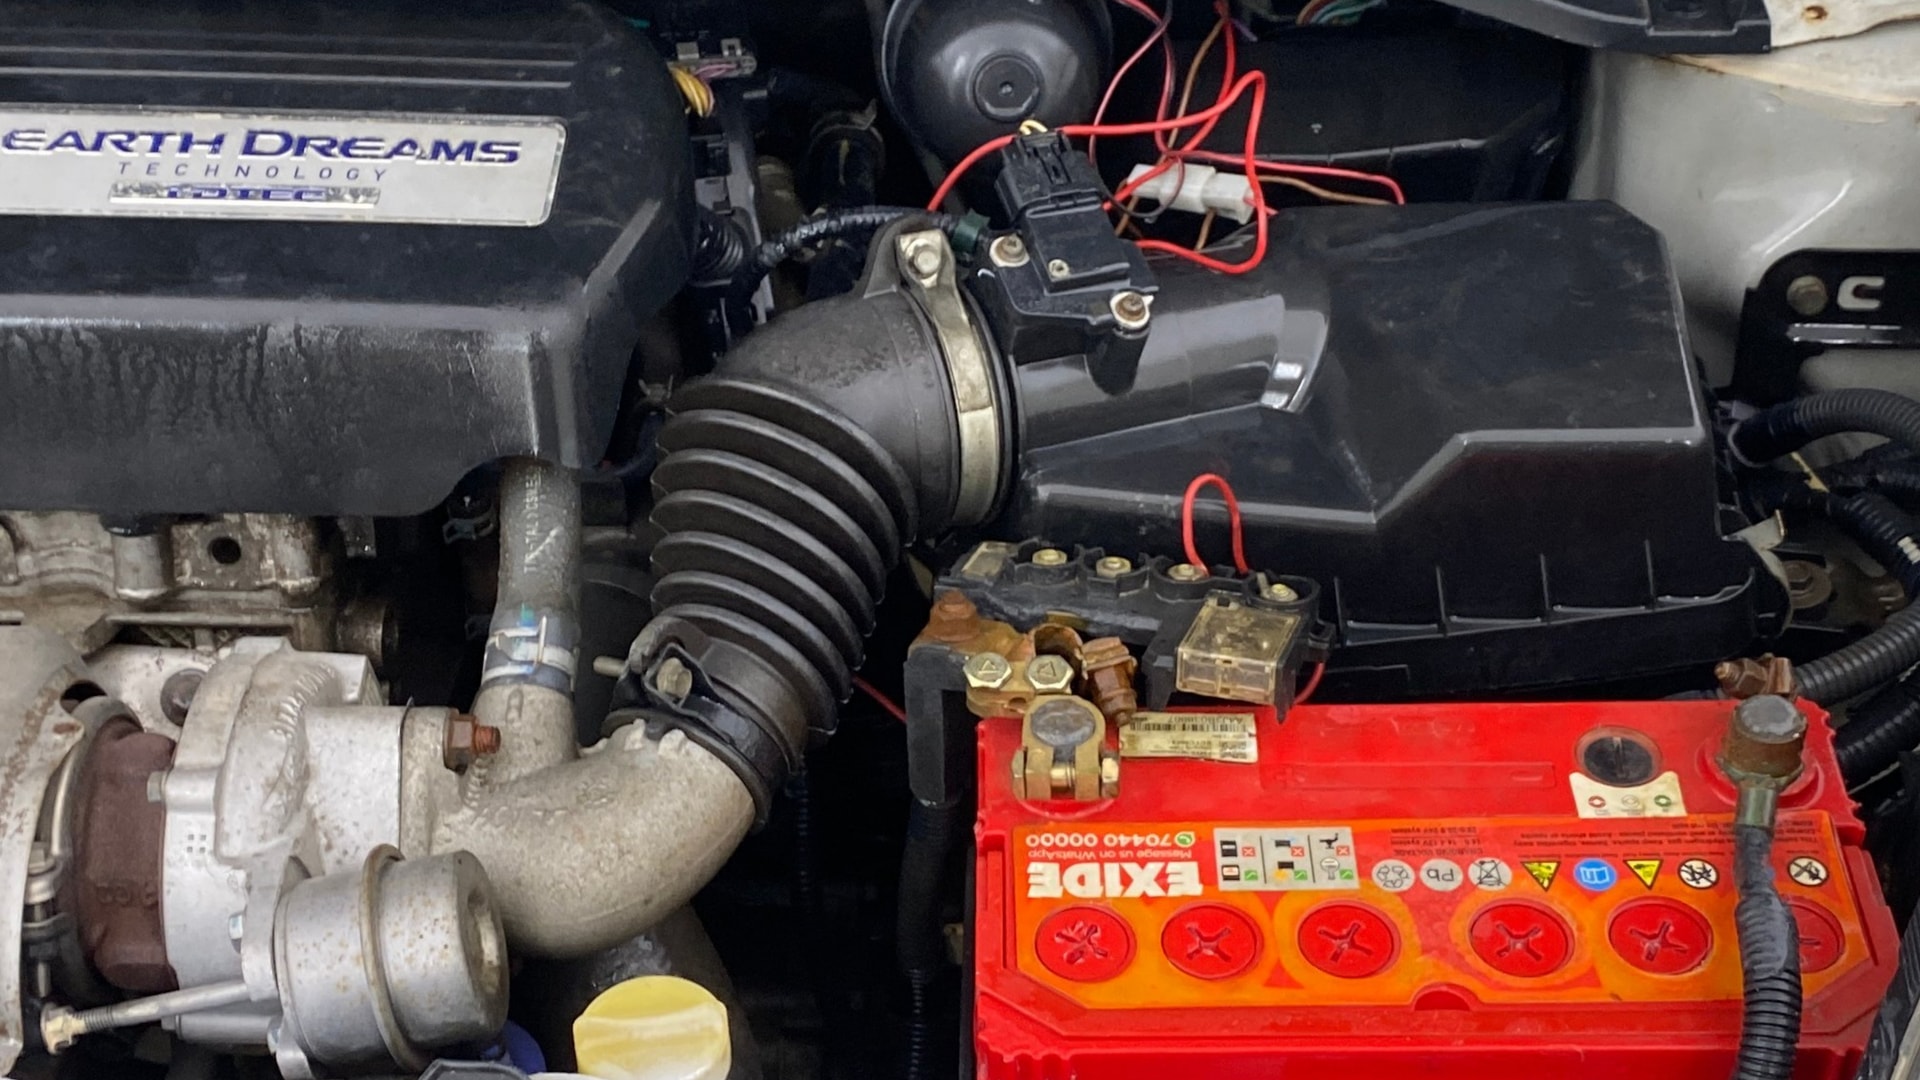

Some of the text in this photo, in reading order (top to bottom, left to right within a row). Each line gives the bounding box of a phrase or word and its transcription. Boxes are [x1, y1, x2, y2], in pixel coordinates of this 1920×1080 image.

[2, 129, 521, 163] EARTH DREAMS
[117, 161, 388, 182] TECHNOLOGY
[1025, 833, 1172, 847] 70440 00000
[1028, 848, 1192, 860] Message us on WhatsApp
[1027, 861, 1203, 898] EXIDE
[1426, 868, 1455, 882] Pb
